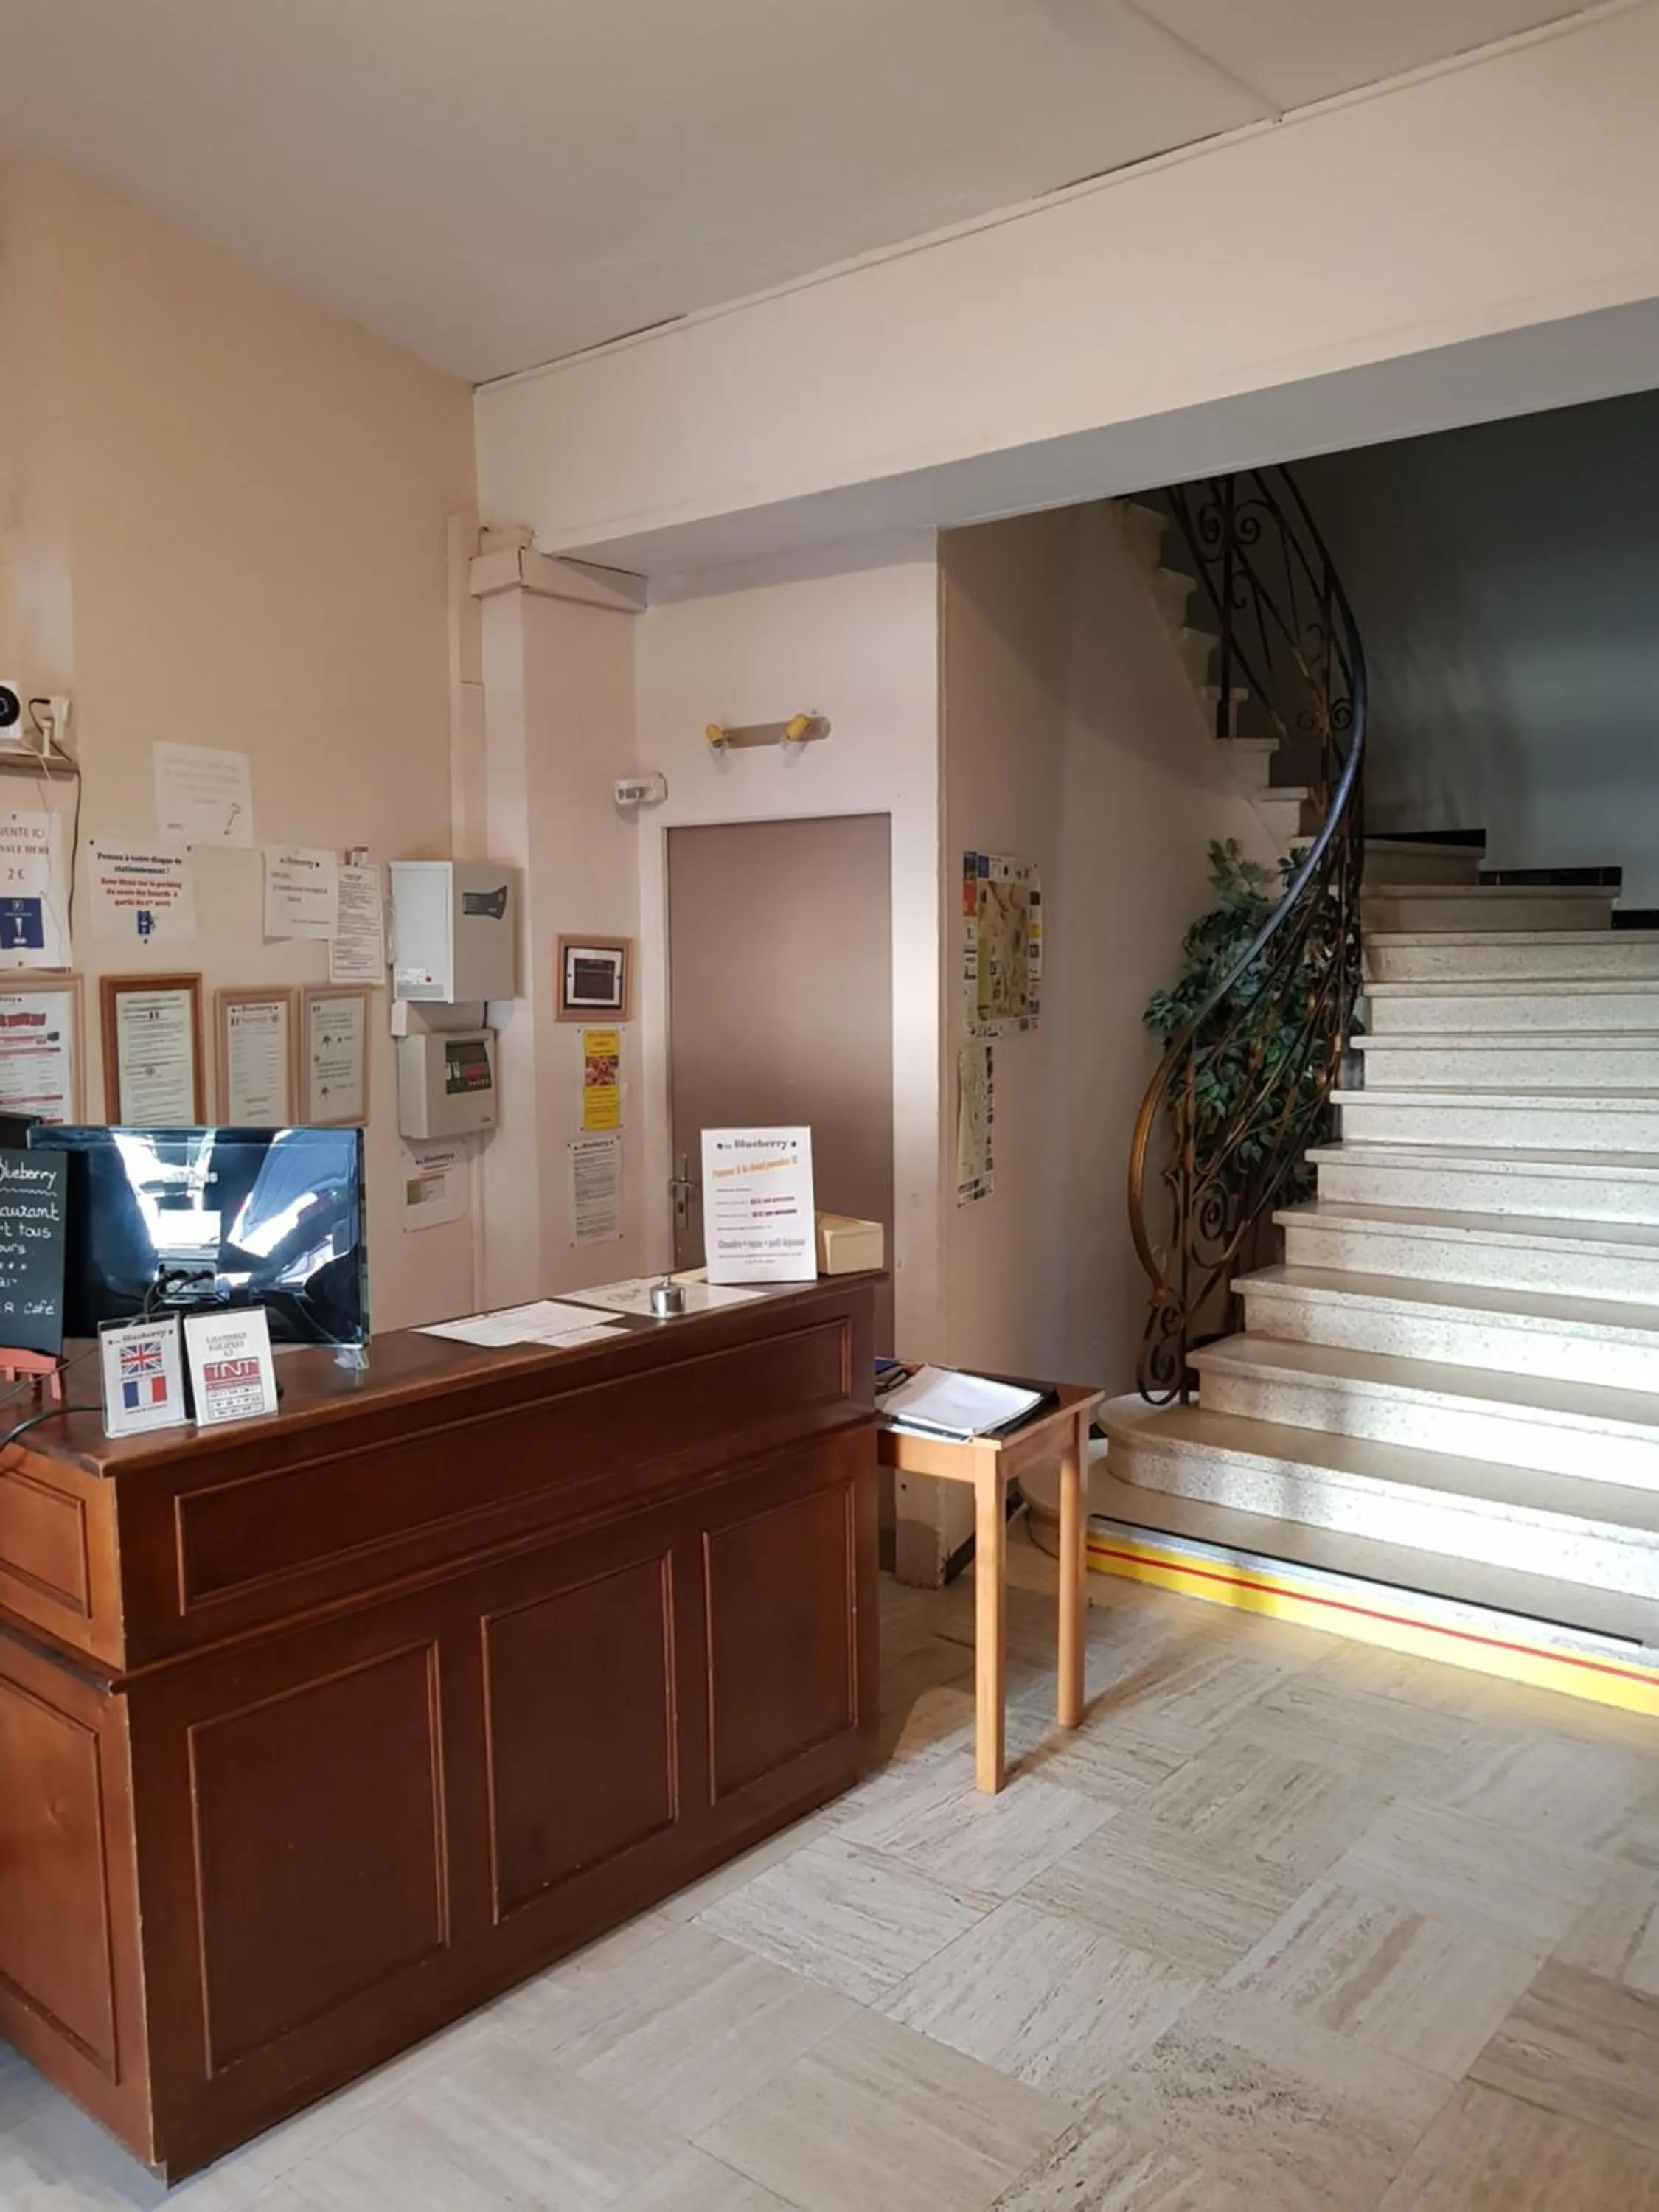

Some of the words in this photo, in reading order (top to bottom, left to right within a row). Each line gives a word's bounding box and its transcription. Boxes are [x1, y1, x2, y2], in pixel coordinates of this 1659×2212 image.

[734, 1138, 787, 1150] Blueberry
[19, 1221, 52, 1239] tous
[206, 1359, 257, 1379] TNT
